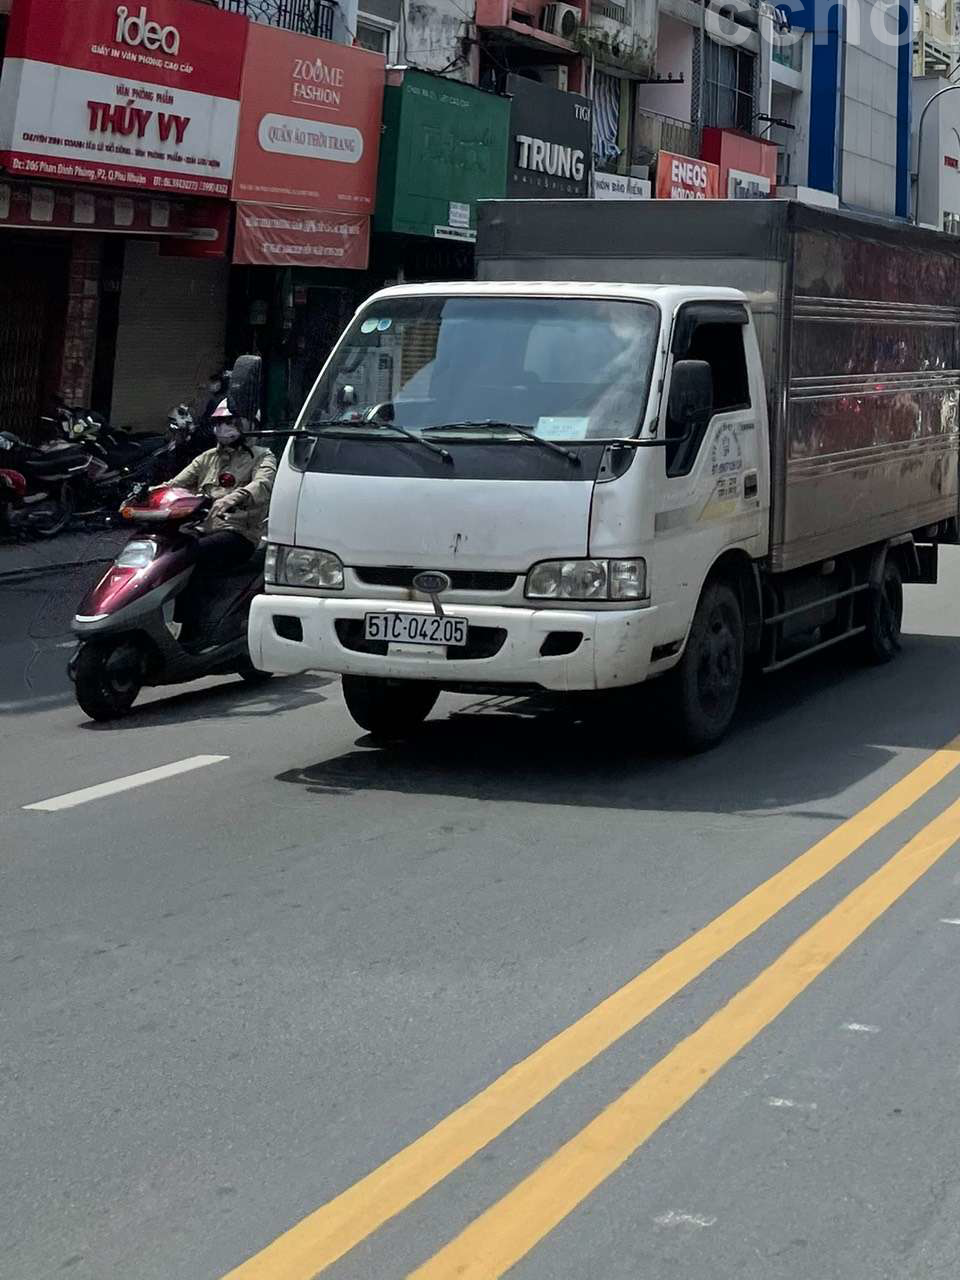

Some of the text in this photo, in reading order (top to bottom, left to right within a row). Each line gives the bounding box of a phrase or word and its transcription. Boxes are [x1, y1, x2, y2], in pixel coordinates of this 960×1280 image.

[115, 5, 180, 56] idea
[293, 83, 340, 105] FASHION
[87, 100, 191, 145] THÚY VY
[516, 134, 585, 181] TRUNG
[671, 160, 708, 188] ENEOS
